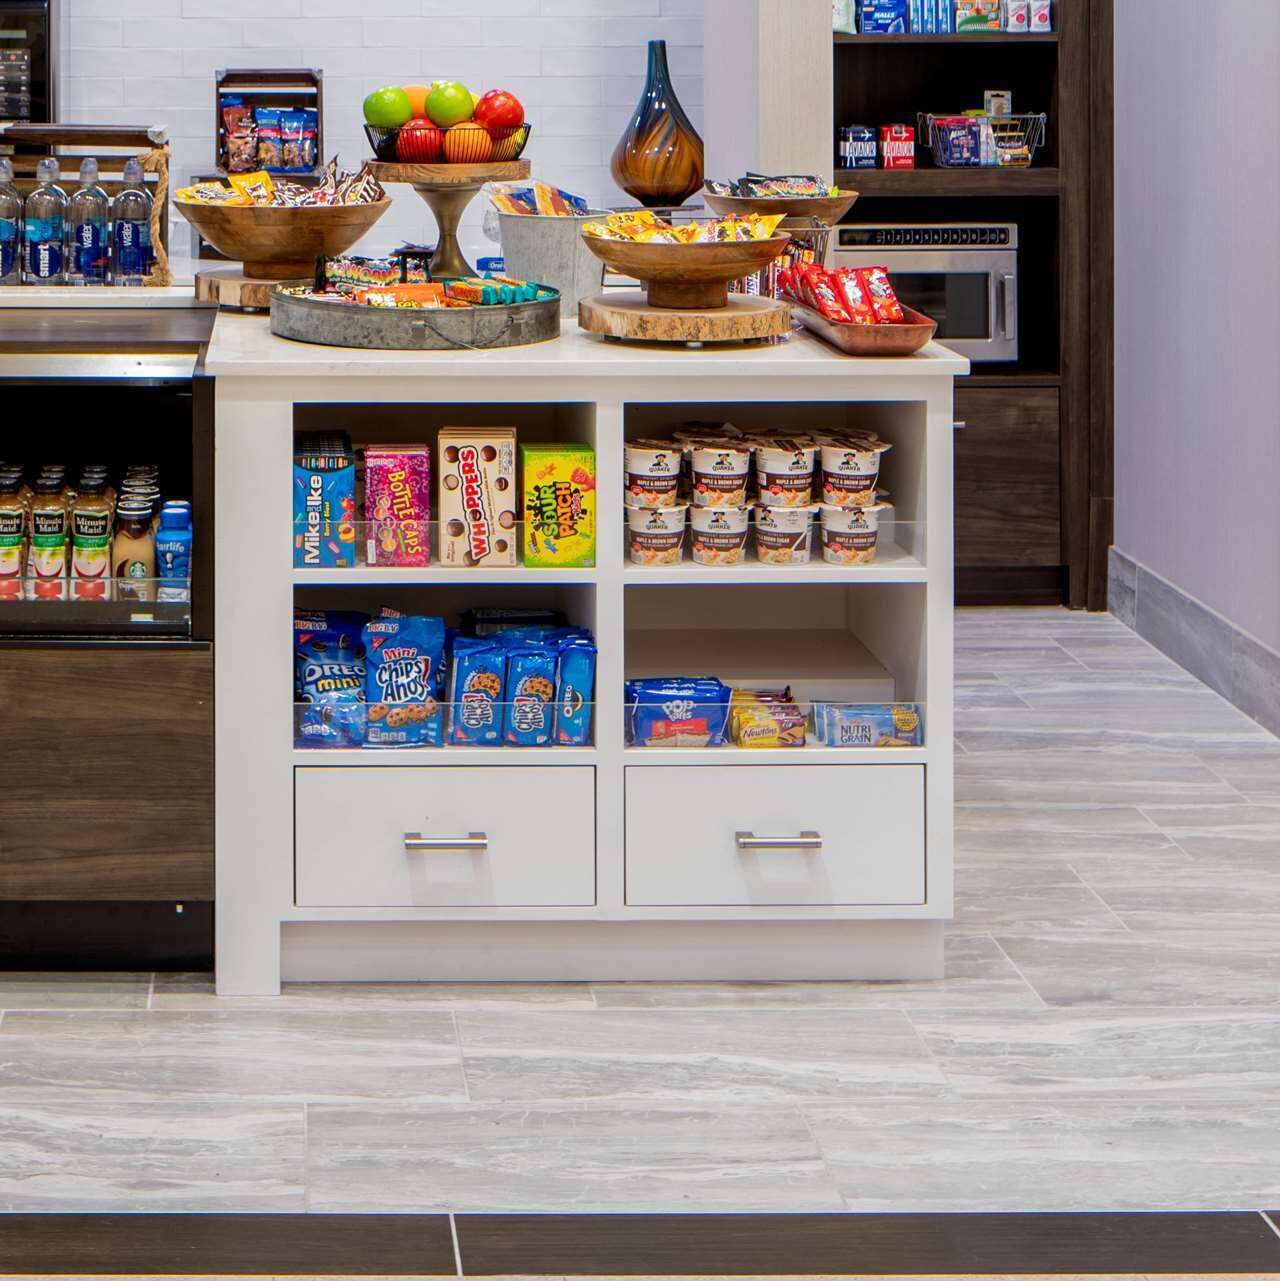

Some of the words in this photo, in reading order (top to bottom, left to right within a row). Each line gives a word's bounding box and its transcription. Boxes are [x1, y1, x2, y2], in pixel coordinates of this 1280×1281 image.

[82, 223, 93, 248] water
[122, 222, 132, 246] water
[38, 243, 49, 277] smart
[387, 470, 415, 519] BOTTLE
[460, 448, 489, 559] WHOPPERS
[35, 516, 62, 524] Minute
[76, 517, 106, 526] Minute
[540, 485, 558, 536] SOUR
[554, 481, 577, 538] PATCH
[38, 524, 60, 532] Maid
[80, 525, 102, 533] Maid
[304, 515, 320, 564] Mike
[400, 519, 422, 554] CAPS
[382, 647, 418, 661] Mini
[305, 664, 368, 683] OREO
[376, 658, 424, 686] Chips
[316, 676, 360, 693] mini
[463, 699, 481, 728] Chips
[514, 702, 532, 732] Chips
[742, 726, 778, 739] Newtons
[840, 734, 872, 744] GRAIN
[841, 724, 872, 735] NUTRI
